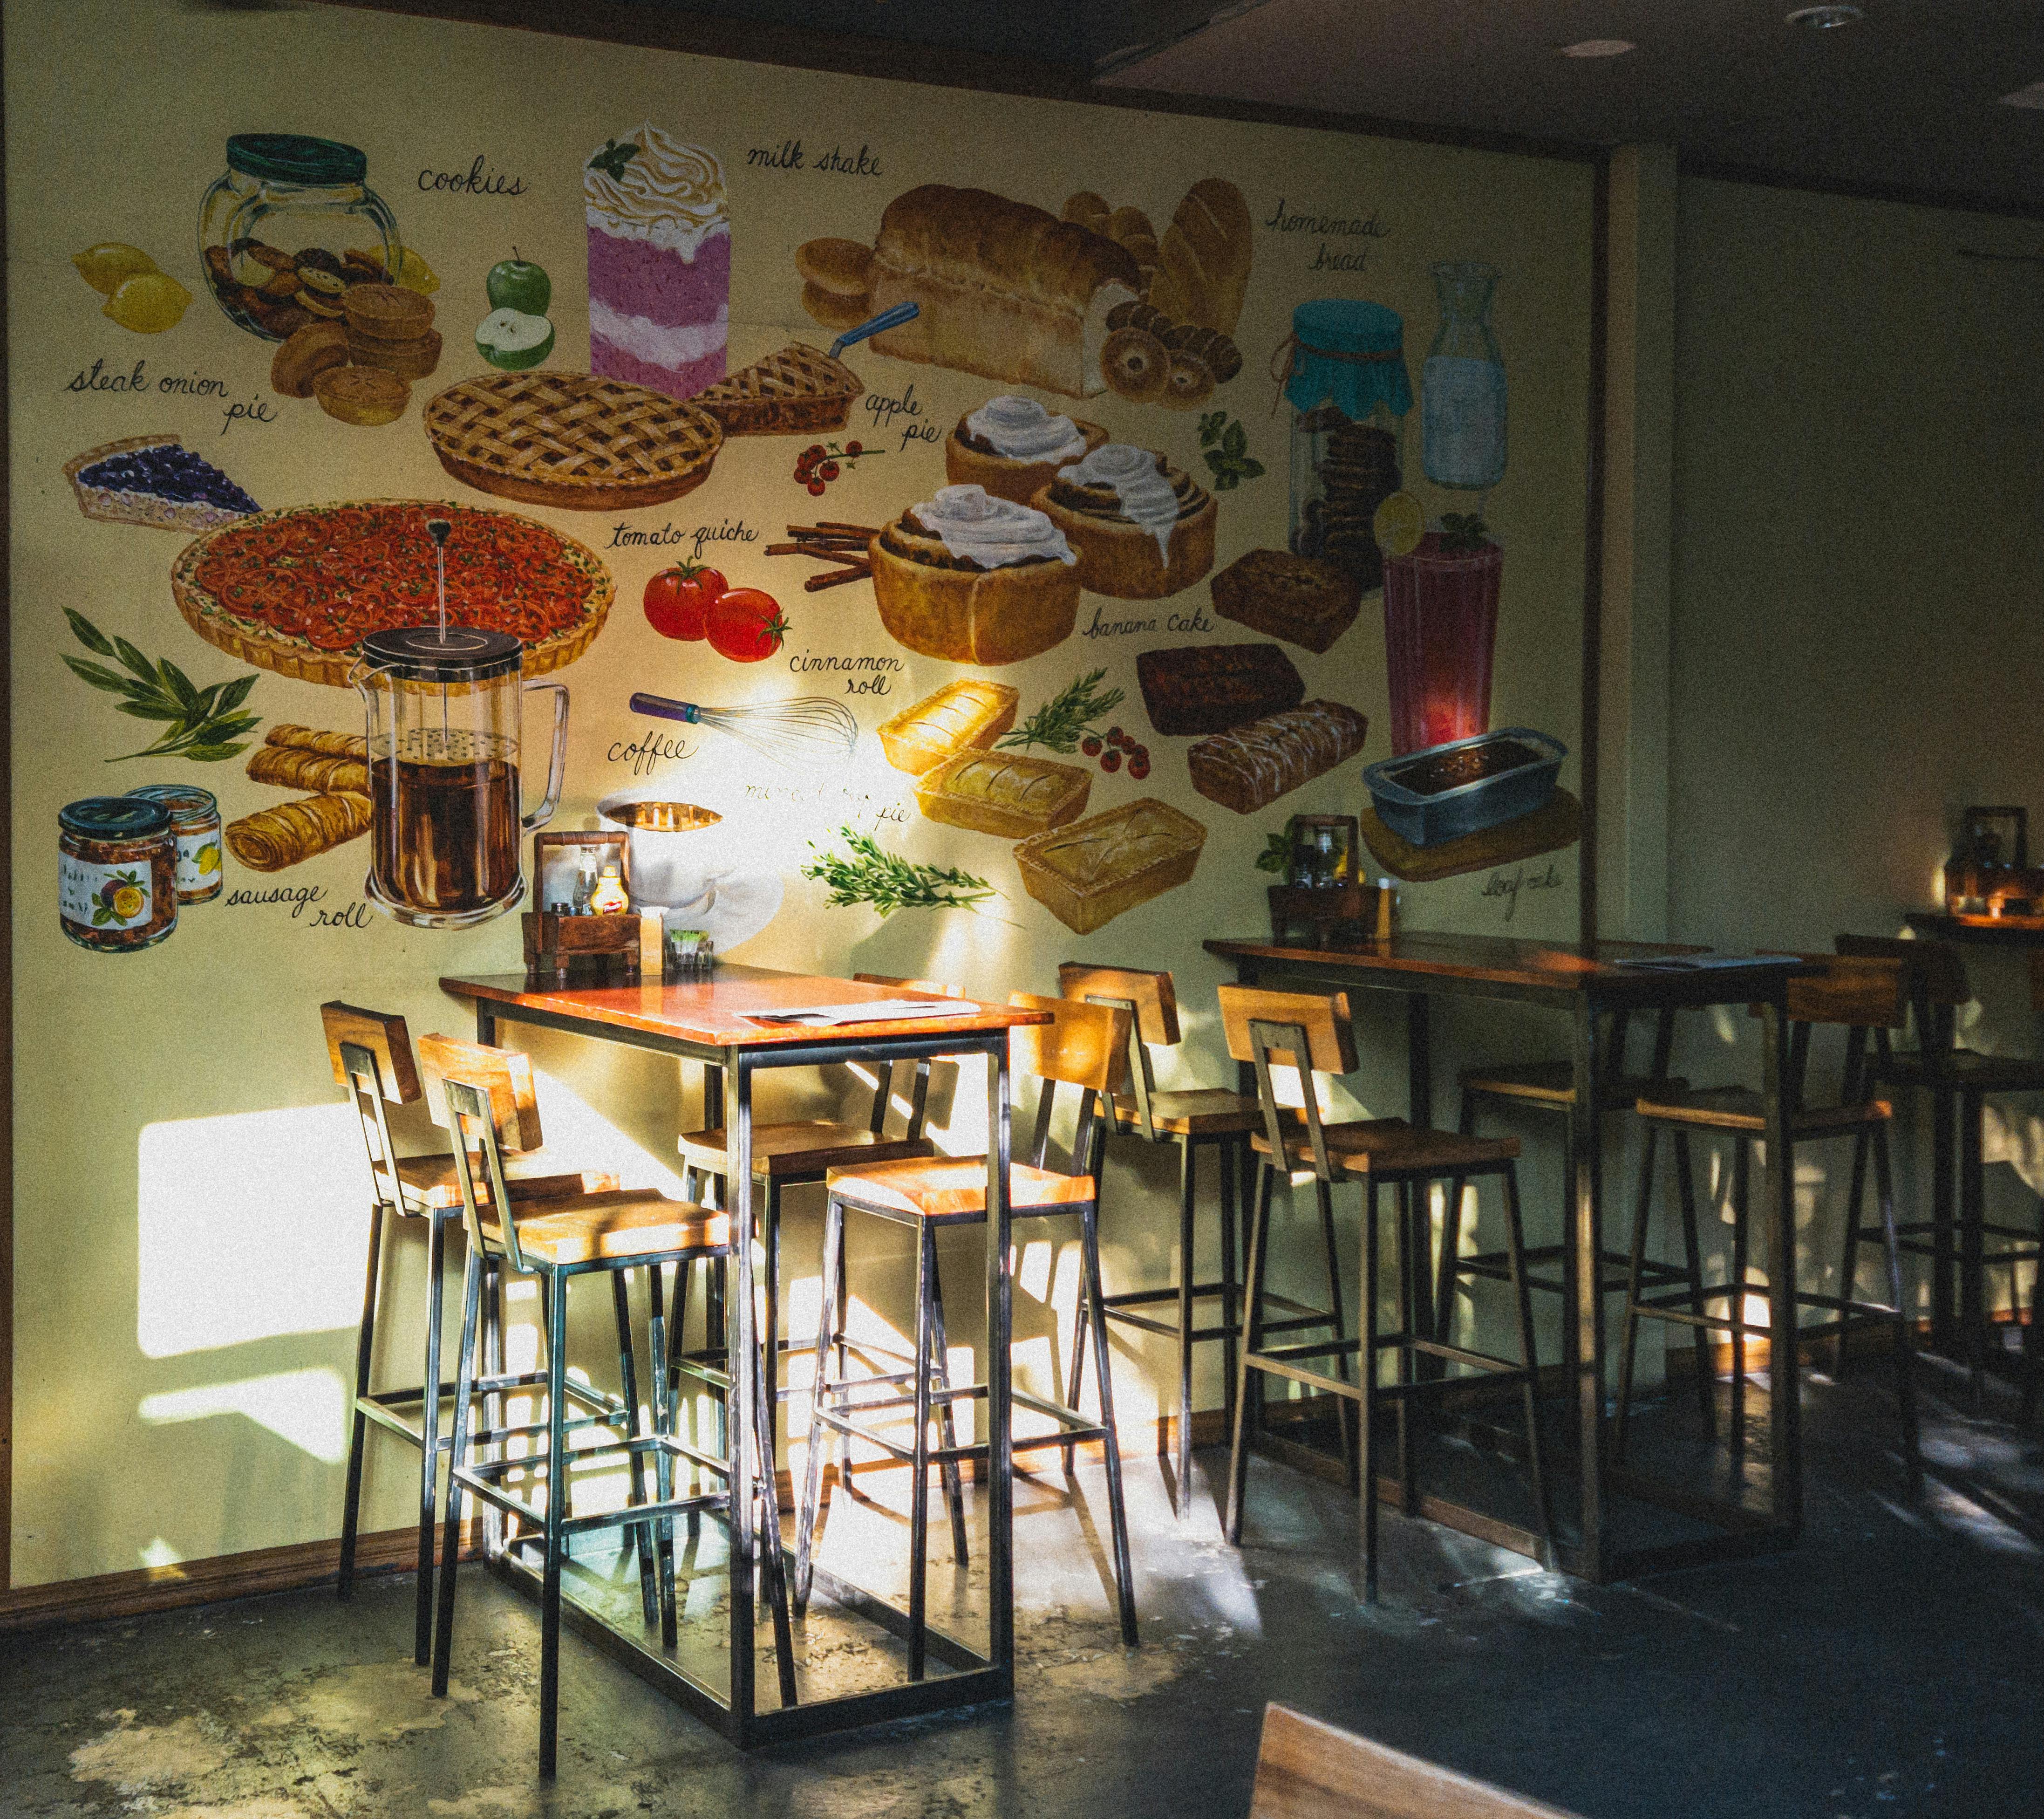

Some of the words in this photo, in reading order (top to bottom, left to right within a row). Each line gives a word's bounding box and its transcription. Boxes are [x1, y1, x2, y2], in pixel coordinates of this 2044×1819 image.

[417, 154, 530, 195] cookies
[747, 139, 804, 169] milk
[812, 144, 884, 176] shake
[1265, 197, 1391, 238] homemade
[61, 358, 149, 392] steak
[159, 370, 229, 397] onion
[221, 393, 278, 436] pie
[865, 383, 923, 427] apple
[899, 418, 942, 453] pie
[603, 521, 687, 549] tomato
[689, 518, 759, 560] quiche
[1082, 607, 1158, 639] banana
[789, 648, 905, 672] cinnamon
[844, 674, 892, 696] roll
[607, 731, 699, 776] coffee
[876, 802, 911, 831] pie
[224, 886, 329, 918] sausage
[309, 902, 373, 929] roll
